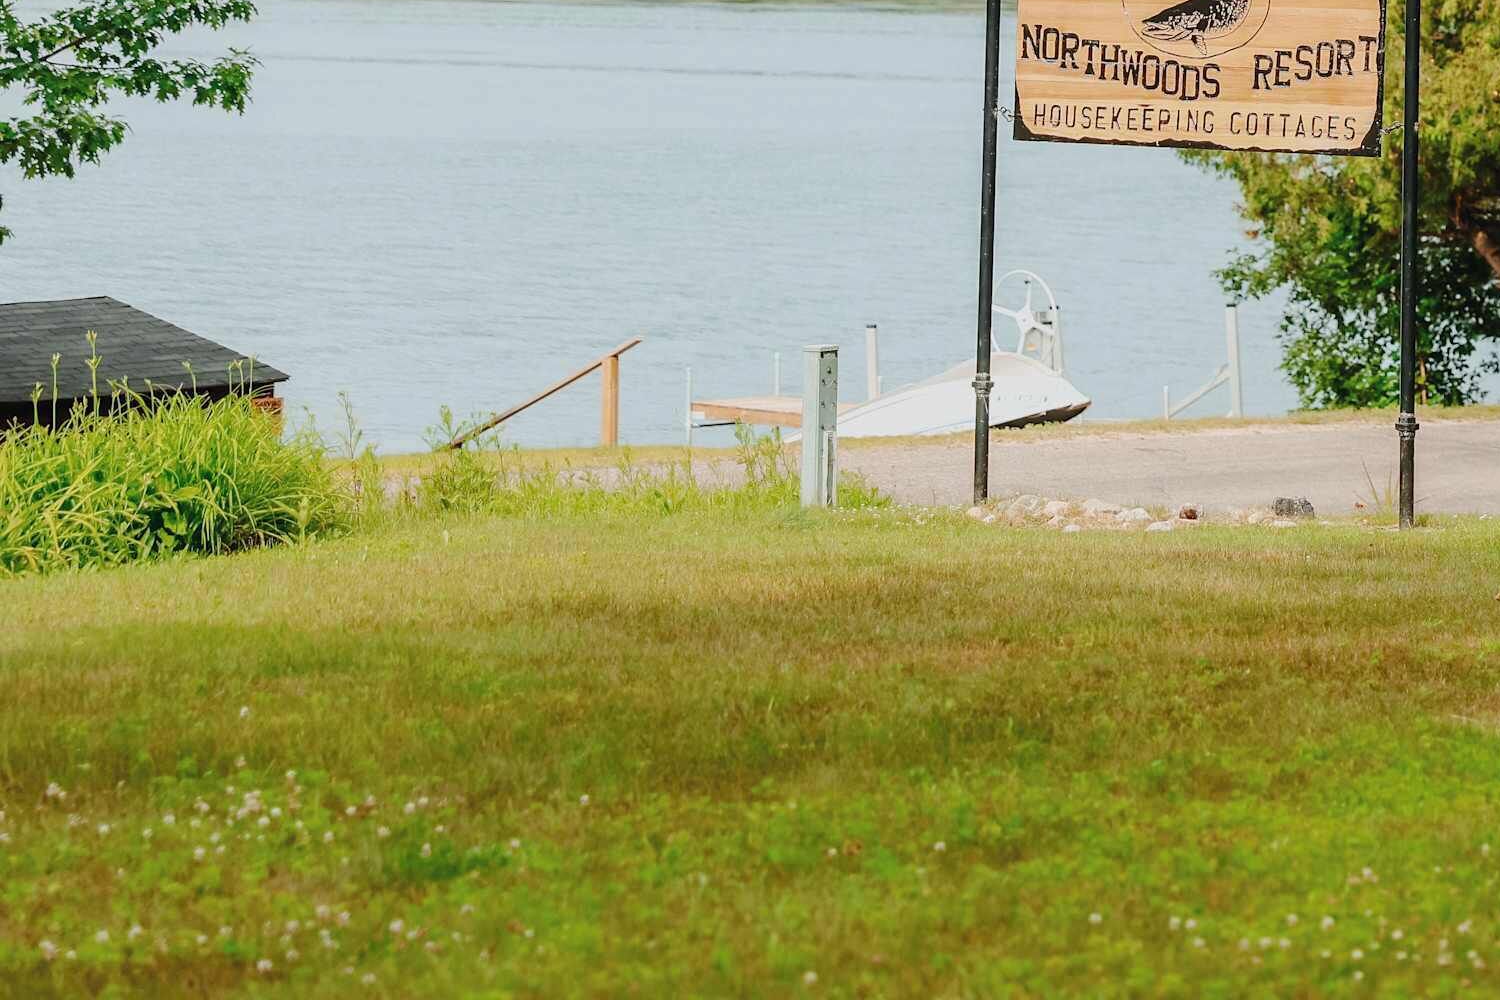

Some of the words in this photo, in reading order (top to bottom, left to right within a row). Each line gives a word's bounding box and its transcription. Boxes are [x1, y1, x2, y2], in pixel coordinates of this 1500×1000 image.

[1020, 23, 1221, 101] NORTHWOODS
[1252, 35, 1377, 90] RESORT
[1033, 103, 1216, 134] HOUSEKEEPING
[1229, 111, 1358, 141] COTTAGES
